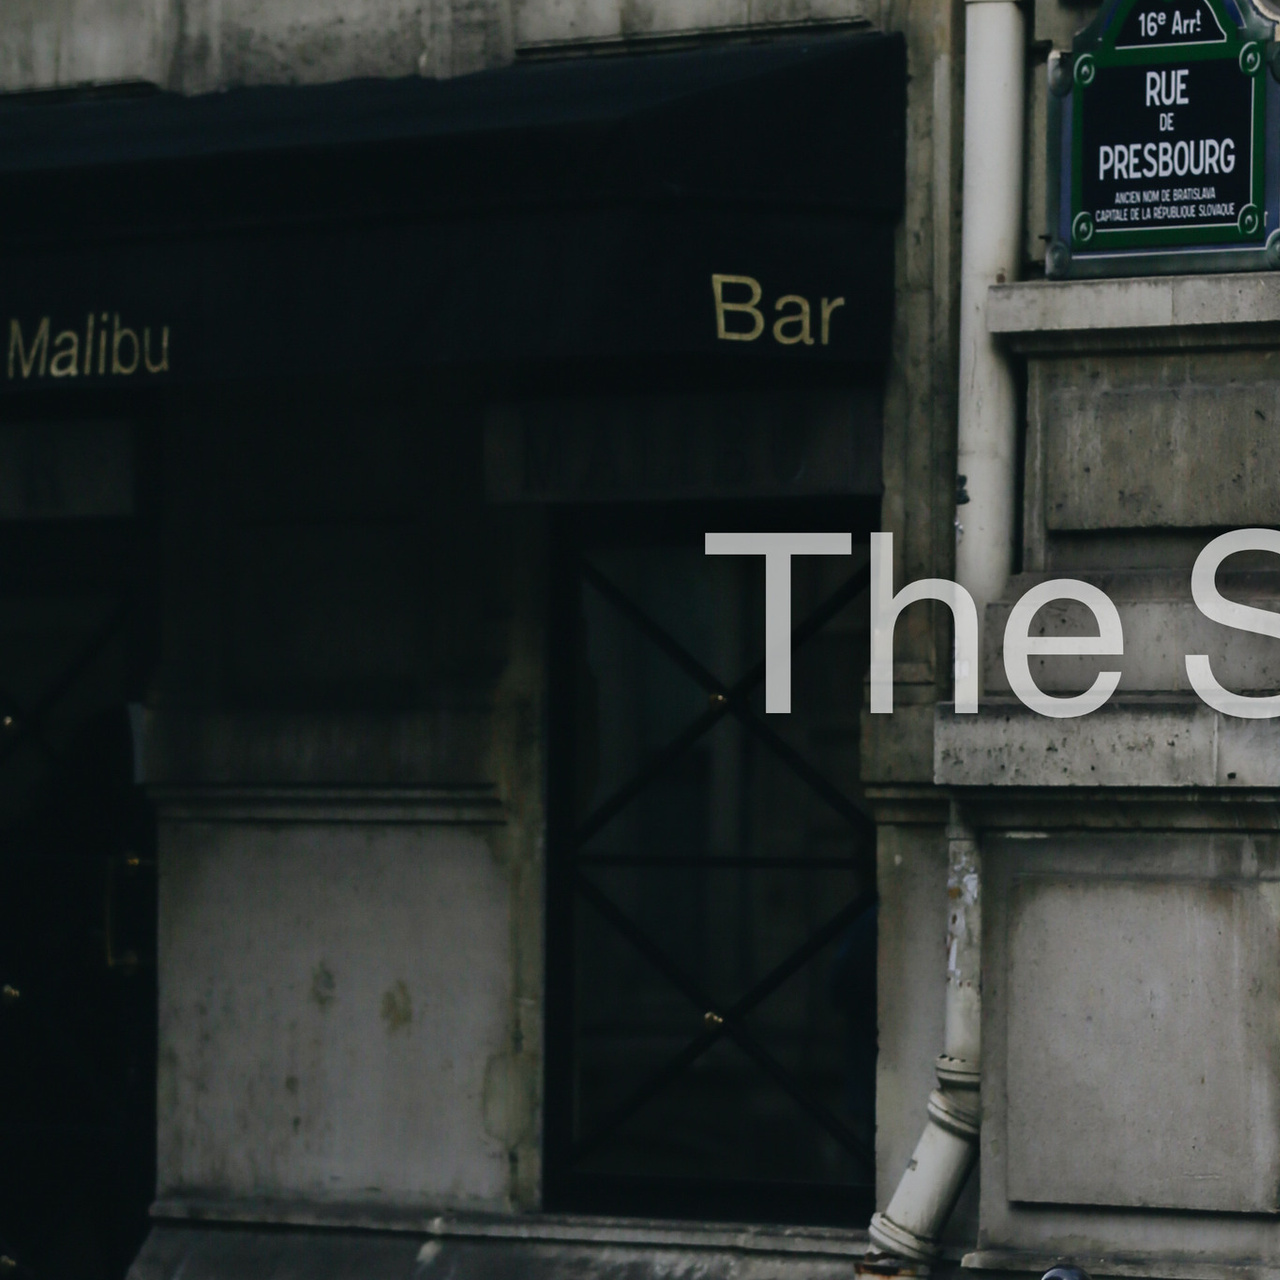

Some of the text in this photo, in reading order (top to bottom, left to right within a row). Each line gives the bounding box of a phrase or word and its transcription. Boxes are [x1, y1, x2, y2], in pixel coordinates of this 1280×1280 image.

[1146, 69, 1190, 107] RUE
[1159, 112, 1175, 131] DE
[1099, 138, 1236, 180] PRESBOURG
[1095, 208, 1128, 222] CAPITALE
[1130, 207, 1140, 220] DE
[1142, 206, 1151, 220] LA
[1198, 202, 1235, 217] SLOVAQUE
[1114, 186, 1216, 204] ANCIEN NOM DE BRATISLAVA
[711, 273, 845, 347] Bar
[7, 313, 172, 380] Malibu
